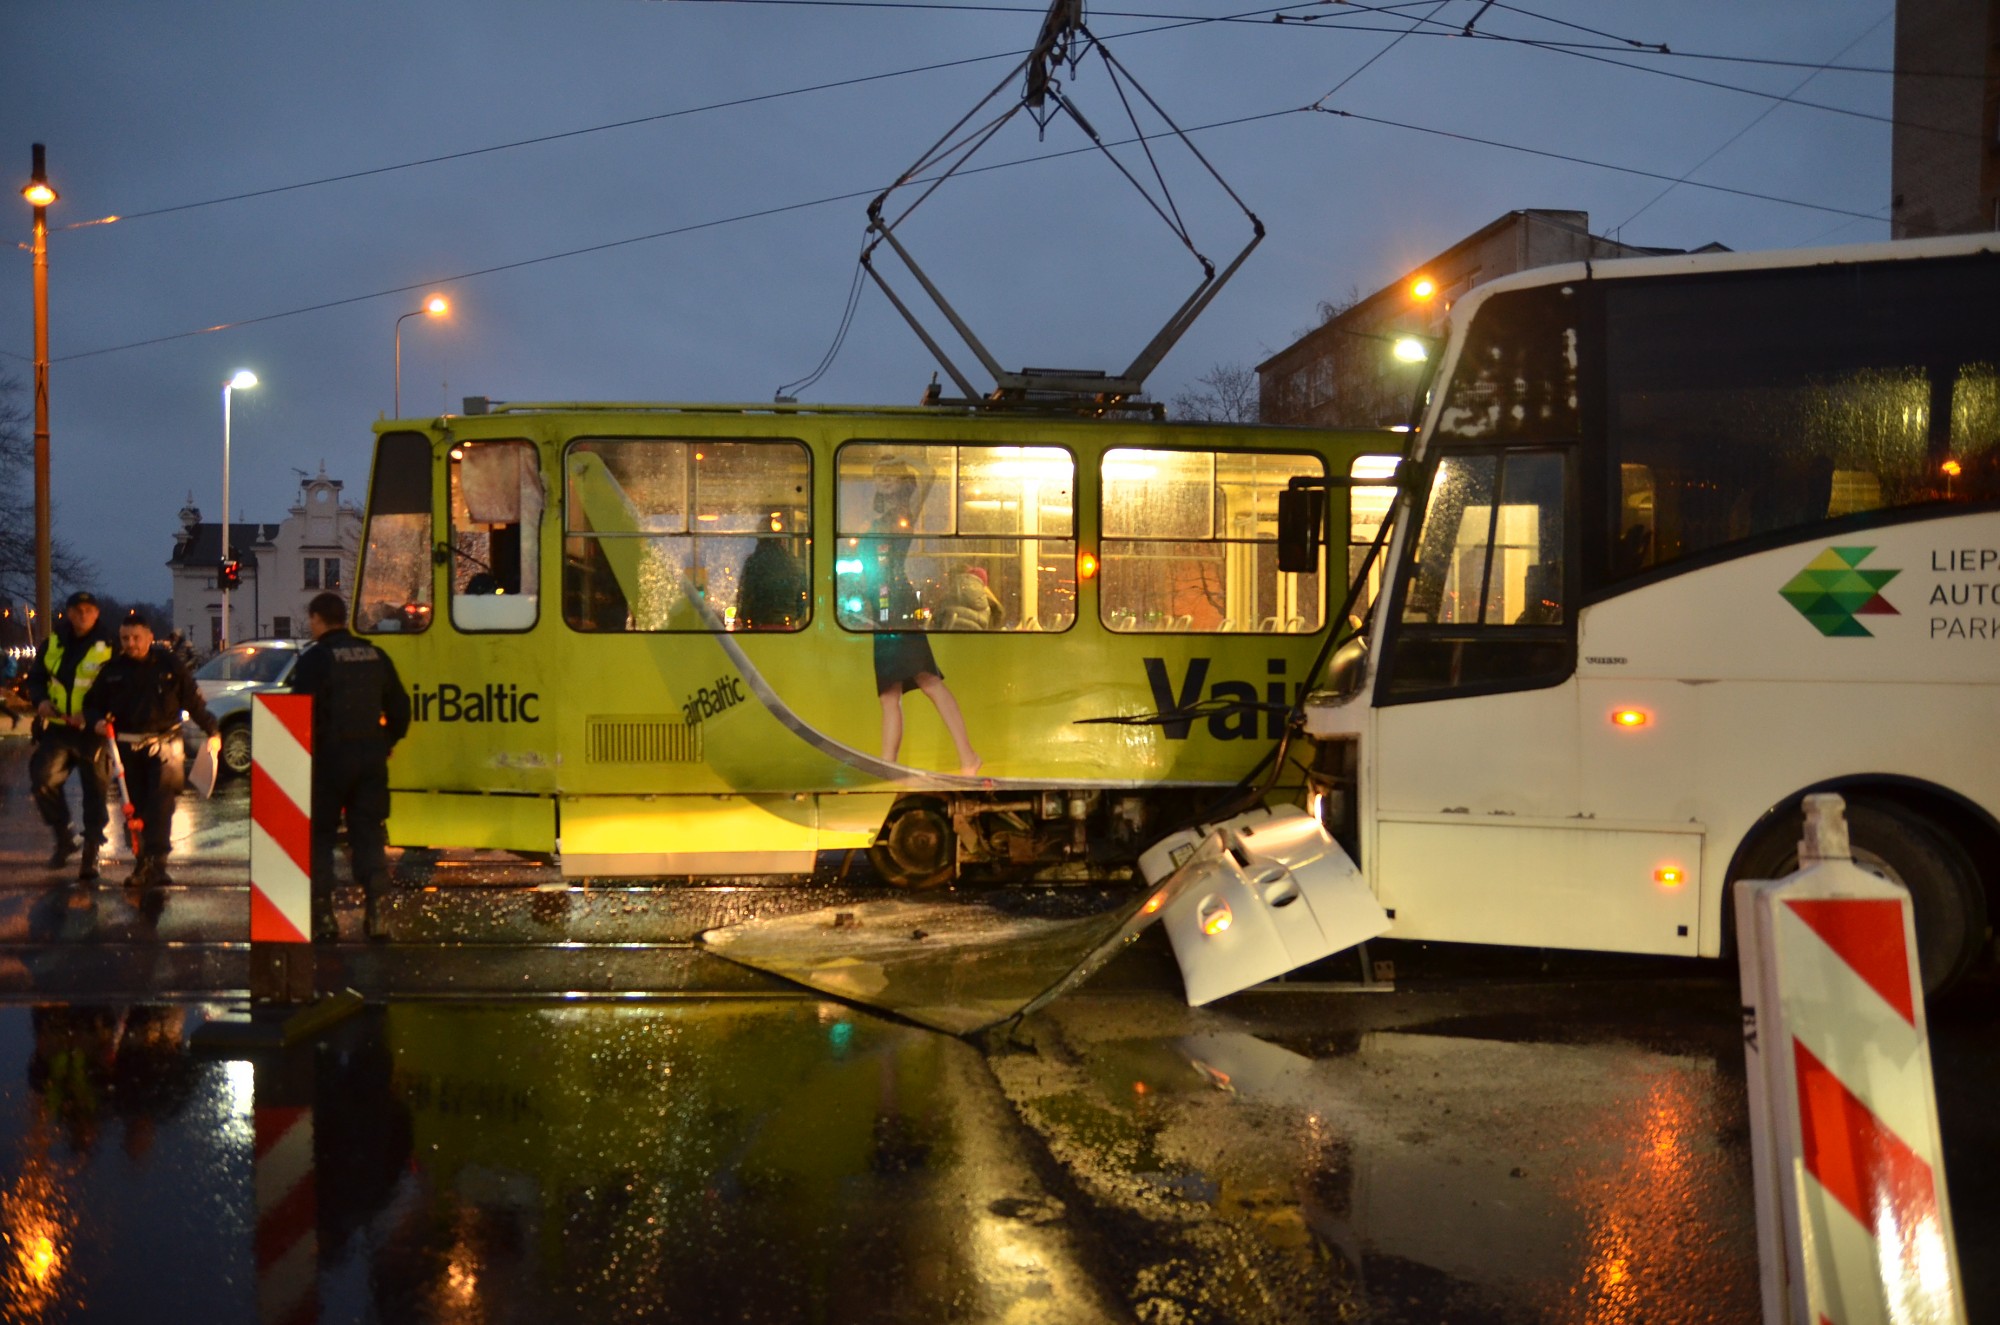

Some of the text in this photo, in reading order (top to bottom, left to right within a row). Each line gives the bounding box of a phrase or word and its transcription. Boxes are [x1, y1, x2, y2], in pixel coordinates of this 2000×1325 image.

[1931, 549, 2000, 571] LIEP
[411, 683, 540, 724] irBaltic
[682, 674, 745, 727] airBaltic
